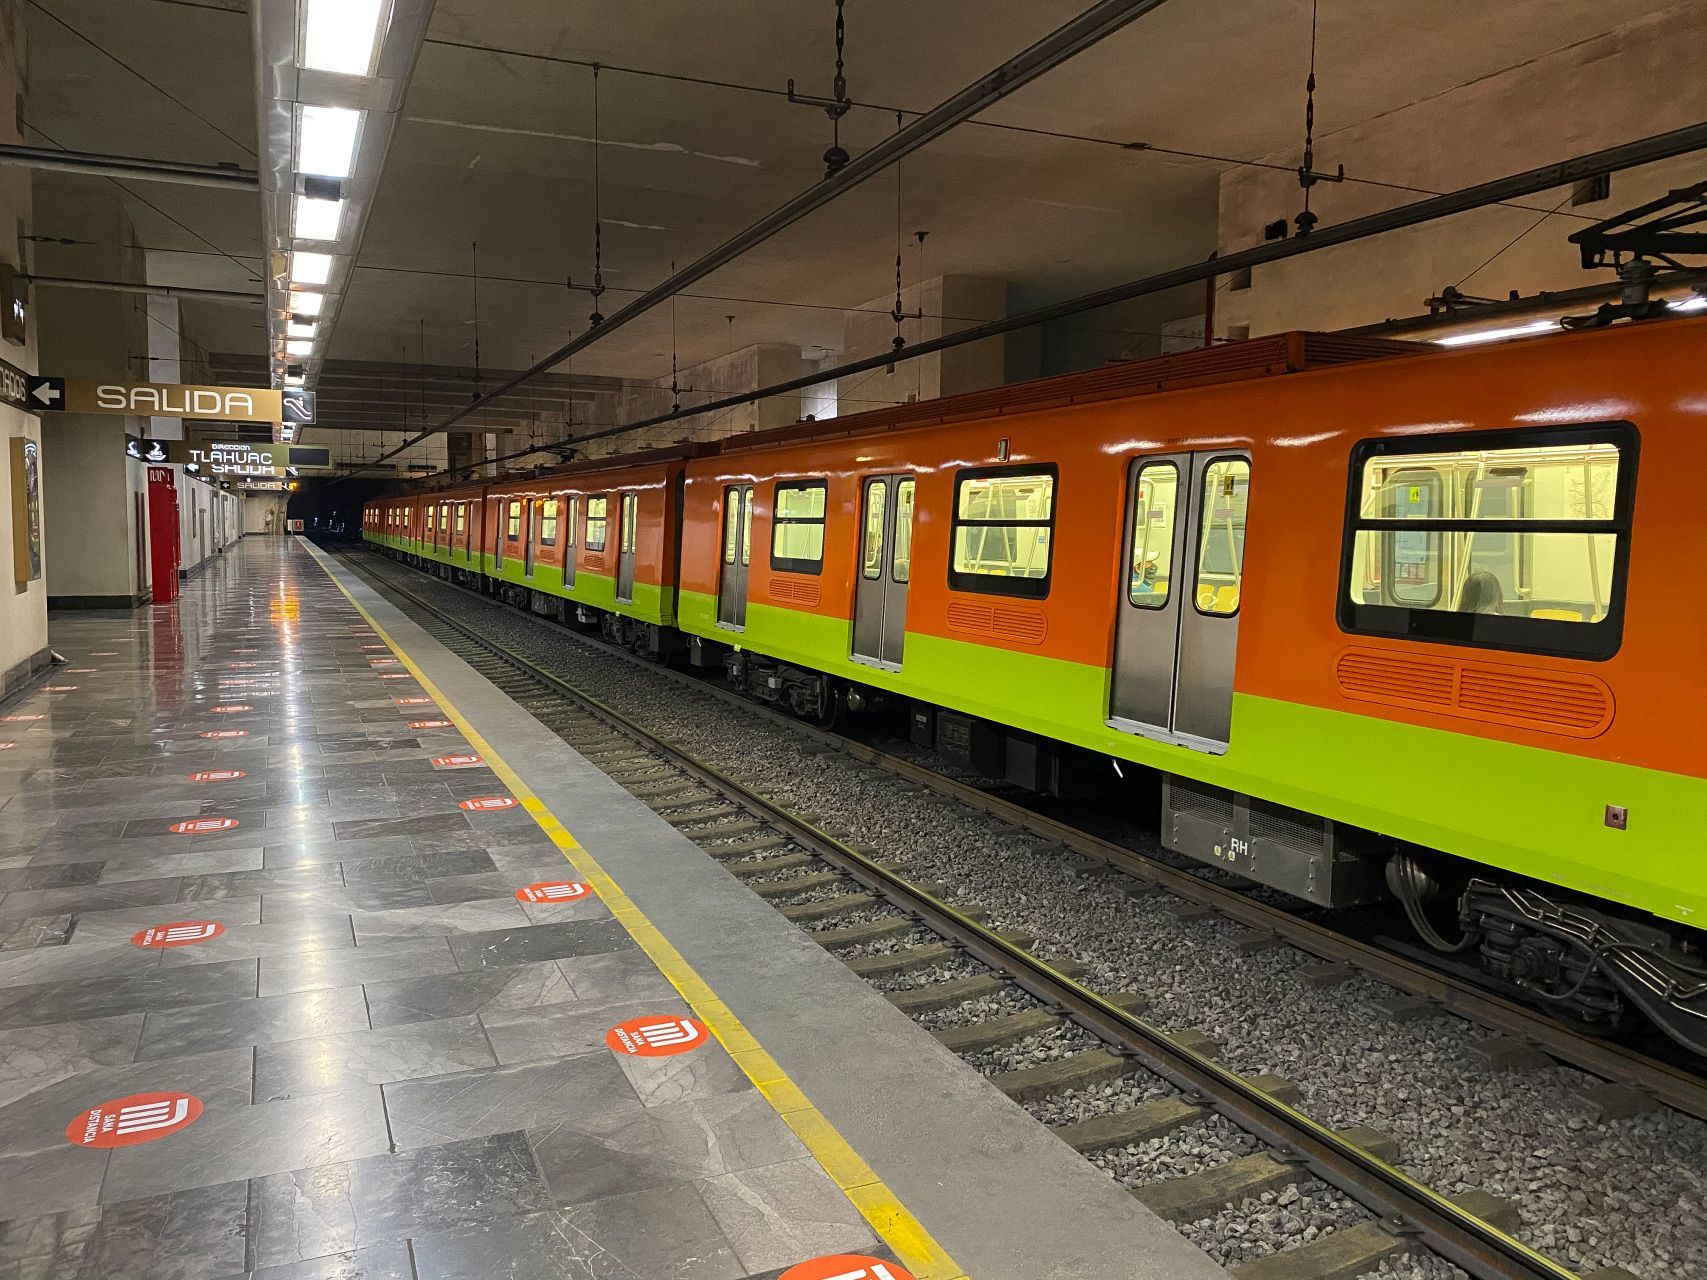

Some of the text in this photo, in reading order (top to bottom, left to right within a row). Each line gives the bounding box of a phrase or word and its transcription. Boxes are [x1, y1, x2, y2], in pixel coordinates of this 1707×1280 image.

[96, 385, 253, 416] SALIDA
[189, 449, 273, 464] TLAHUAC
[1231, 837, 1248, 856] RH
[614, 1028, 638, 1054] DISTANCIA
[82, 1109, 102, 1144] DISTANCIA
[101, 1114, 116, 1133] SANA
